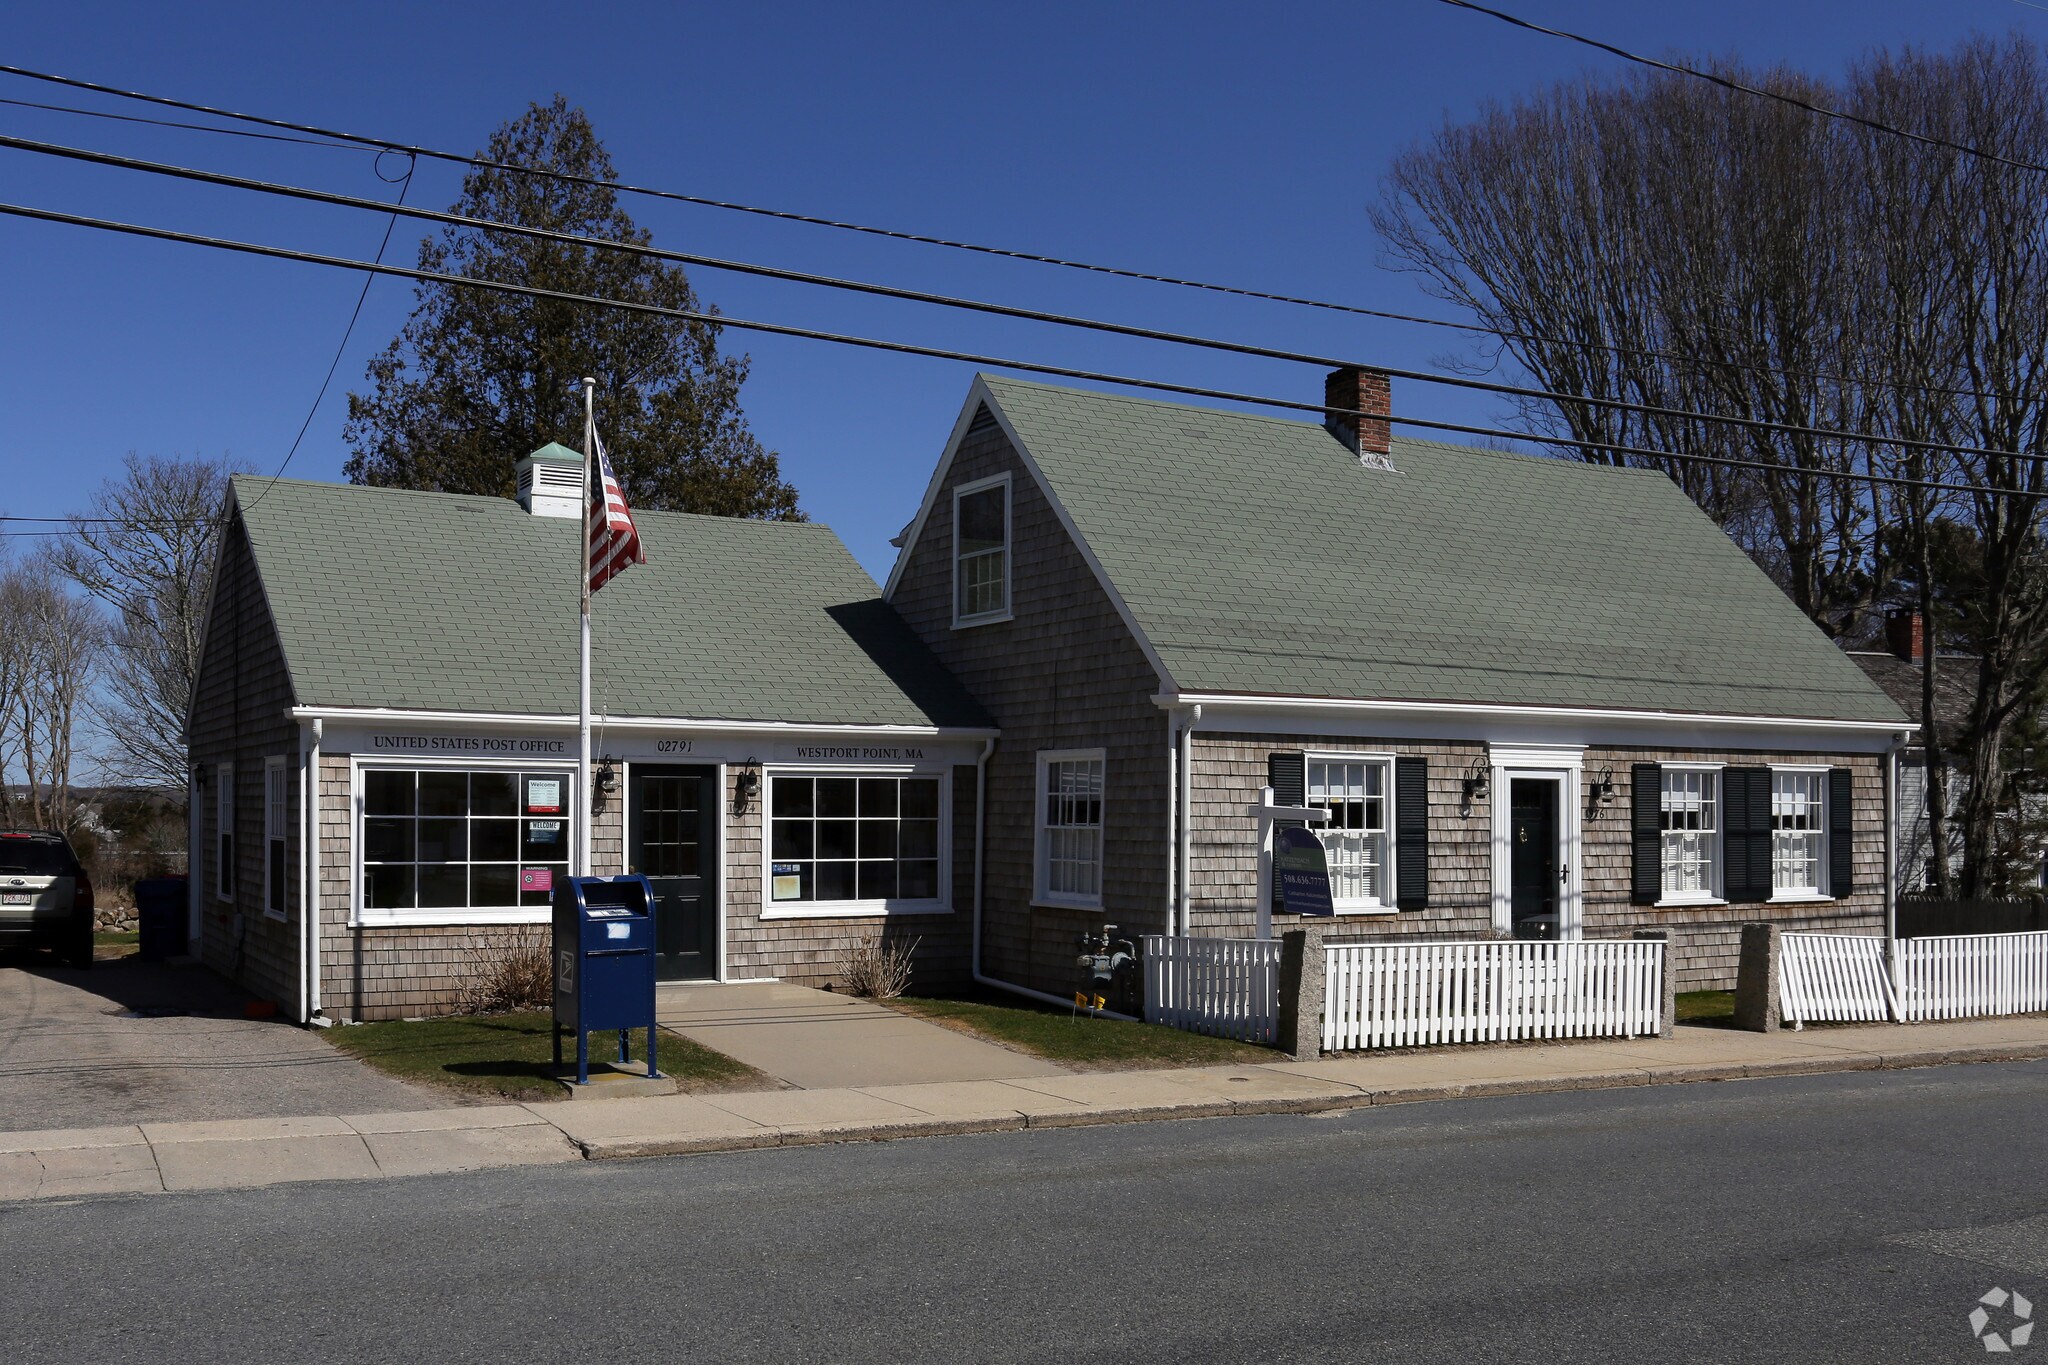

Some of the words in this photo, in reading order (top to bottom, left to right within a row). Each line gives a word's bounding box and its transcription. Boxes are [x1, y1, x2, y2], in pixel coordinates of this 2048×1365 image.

[374, 736, 428, 749] UNITED
[431, 737, 479, 750] STATES
[483, 739, 517, 751] POST
[519, 740, 565, 753] OFFICE
[657, 740, 692, 753] 02791
[797, 747, 860, 759] WESTPORT
[863, 749, 901, 761] POINT,
[905, 749, 924, 760] MA
[532, 821, 557, 829] WELCOME
[1284, 874, 1326, 886] 508.636.7777
